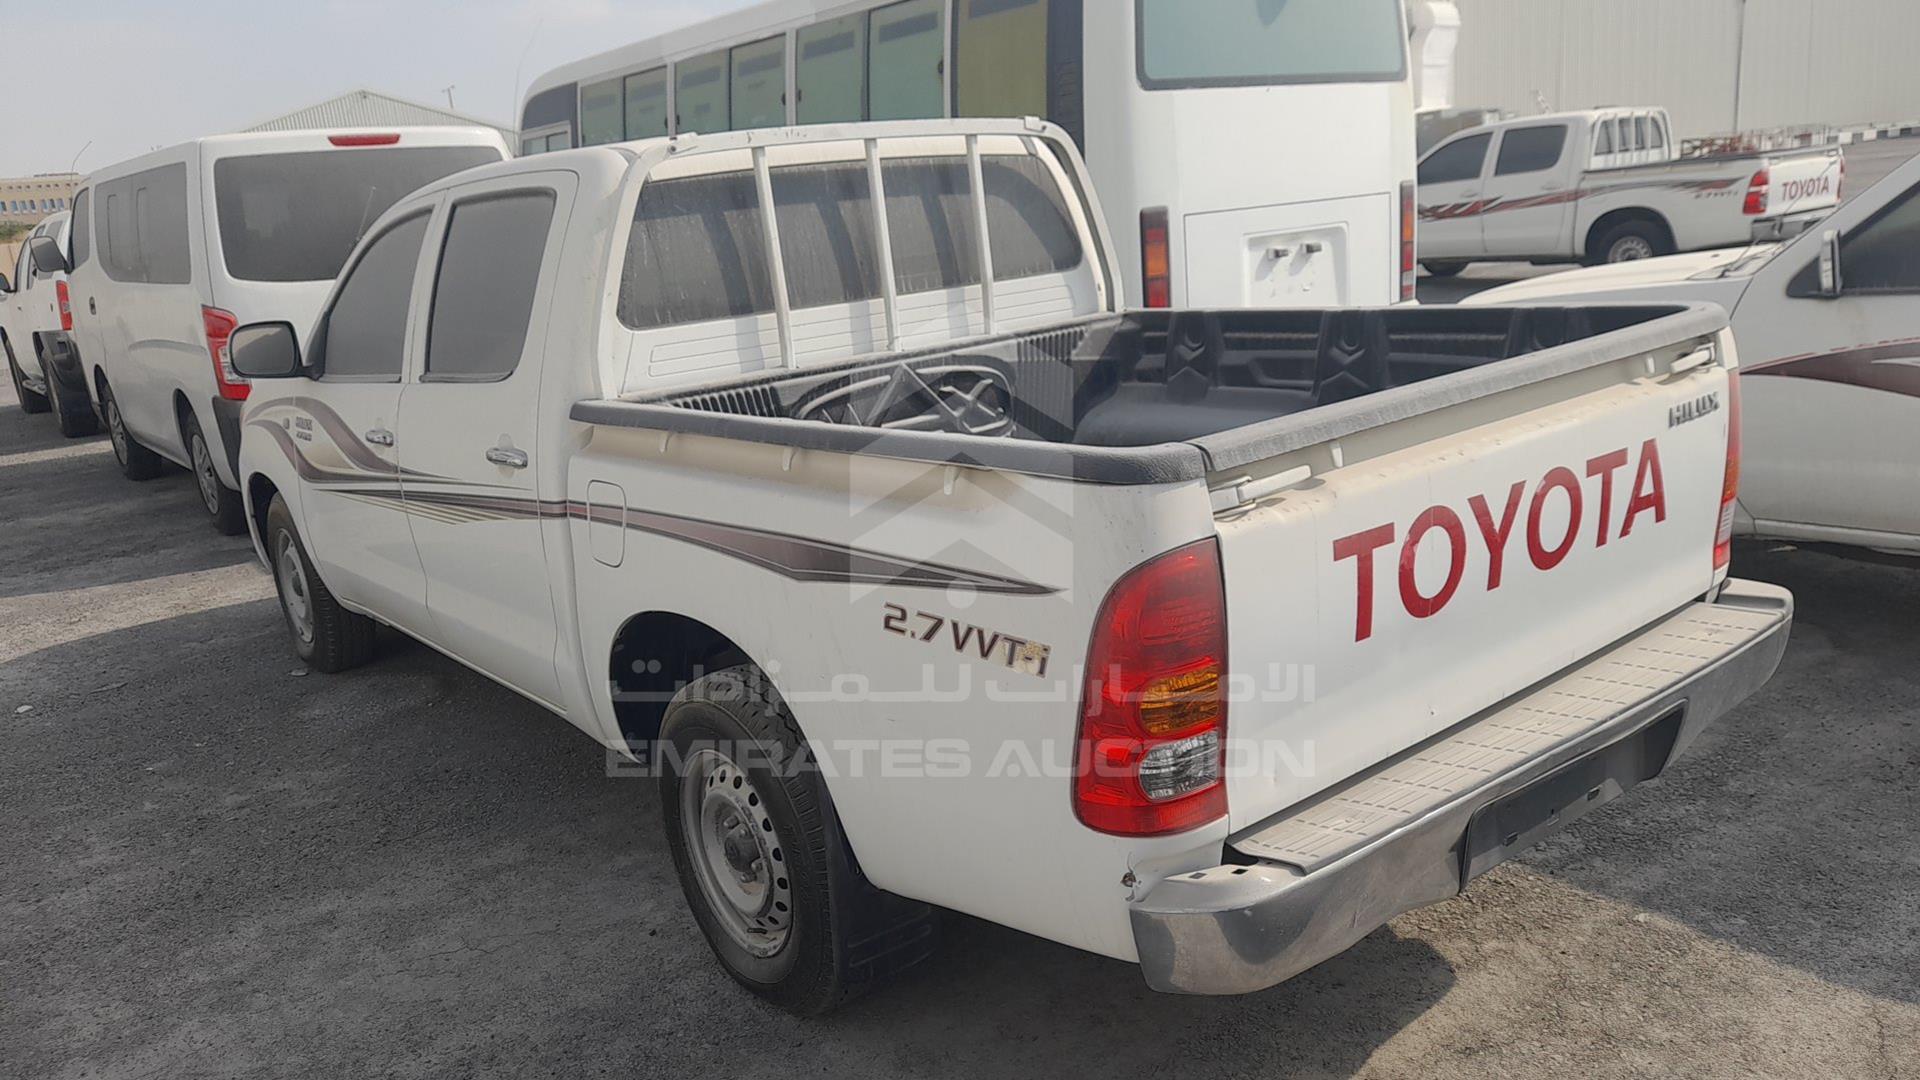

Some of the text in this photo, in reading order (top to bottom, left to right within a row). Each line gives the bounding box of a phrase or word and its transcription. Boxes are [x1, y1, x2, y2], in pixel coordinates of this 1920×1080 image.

[1781, 175, 1830, 201] TOYOTA
[1668, 391, 1720, 429] HILUX
[1332, 438, 1667, 643] TOYOTA
[883, 602, 1051, 679] 2.7 VVT-i
